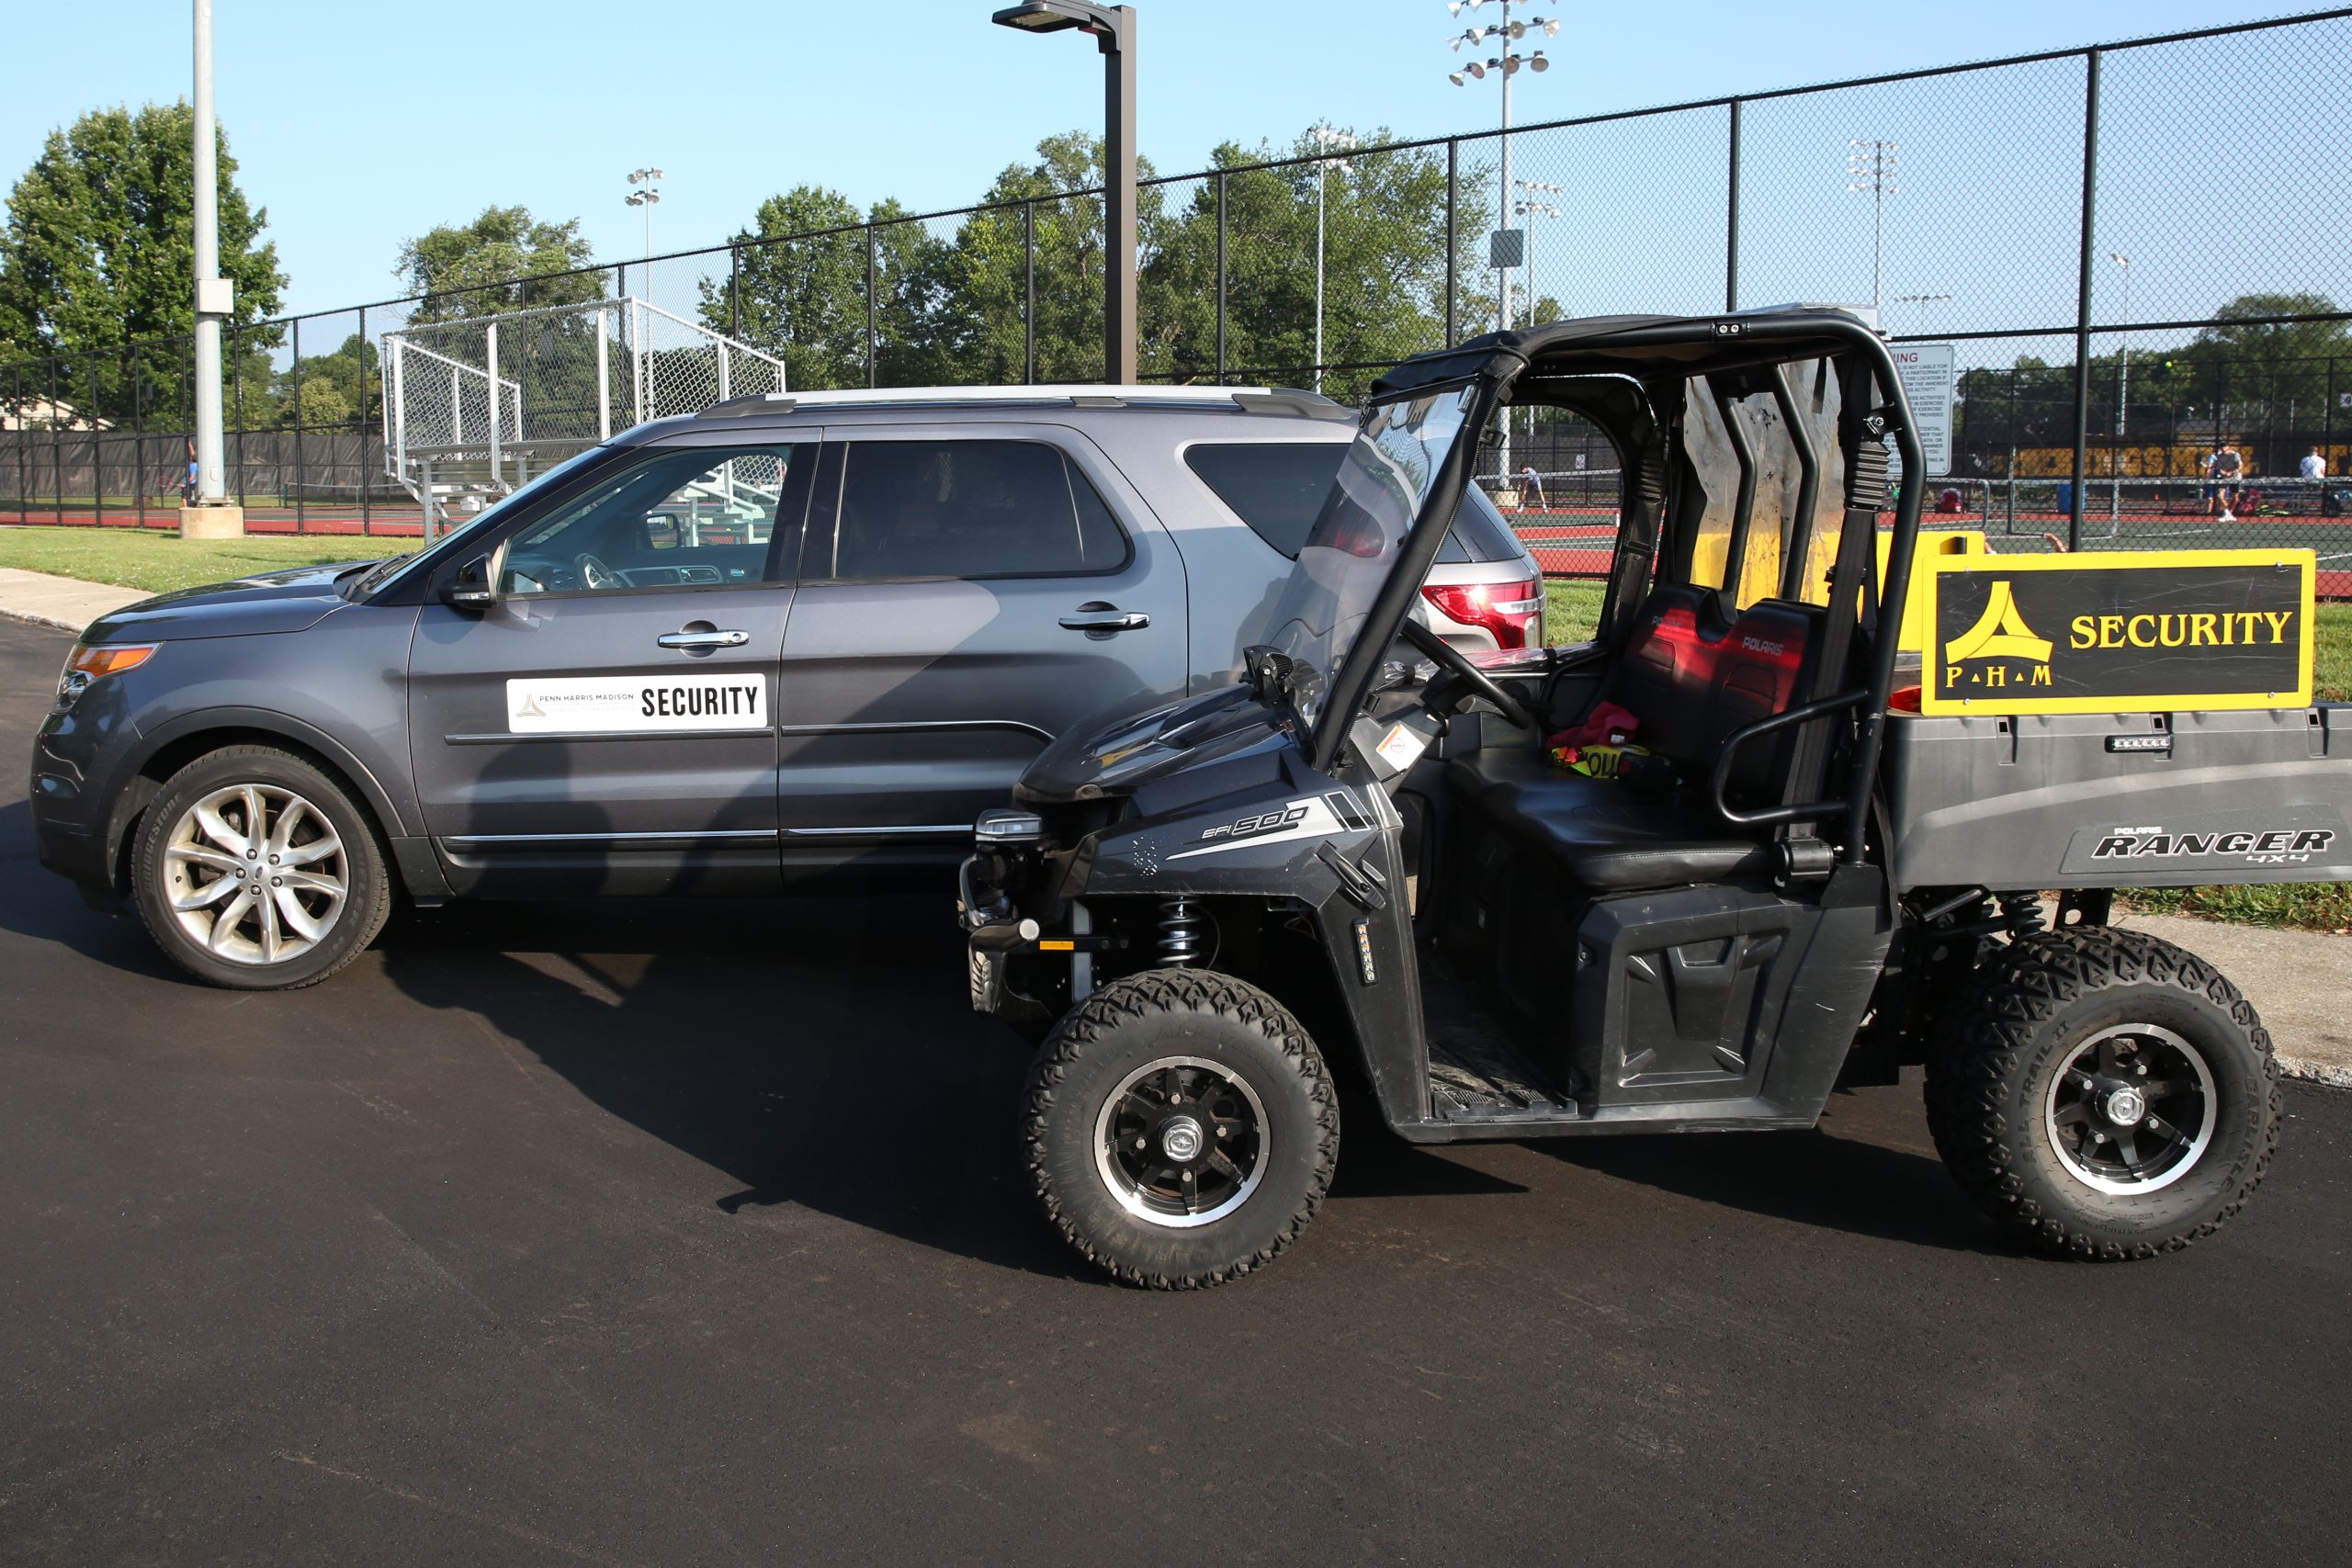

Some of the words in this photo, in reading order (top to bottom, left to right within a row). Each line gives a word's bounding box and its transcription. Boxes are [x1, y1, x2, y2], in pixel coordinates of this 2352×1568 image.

[2069, 611, 2293, 650] SECURITY
[1741, 636, 1784, 658] POLARIS
[641, 686, 758, 717] SECURITY
[1201, 824, 1233, 840] EFI
[1231, 806, 1310, 837] 500
[2114, 826, 2163, 836] POLARIS
[2090, 829, 2337, 860] RANGER
[2220, 1077, 2260, 1192] CARLISLE
